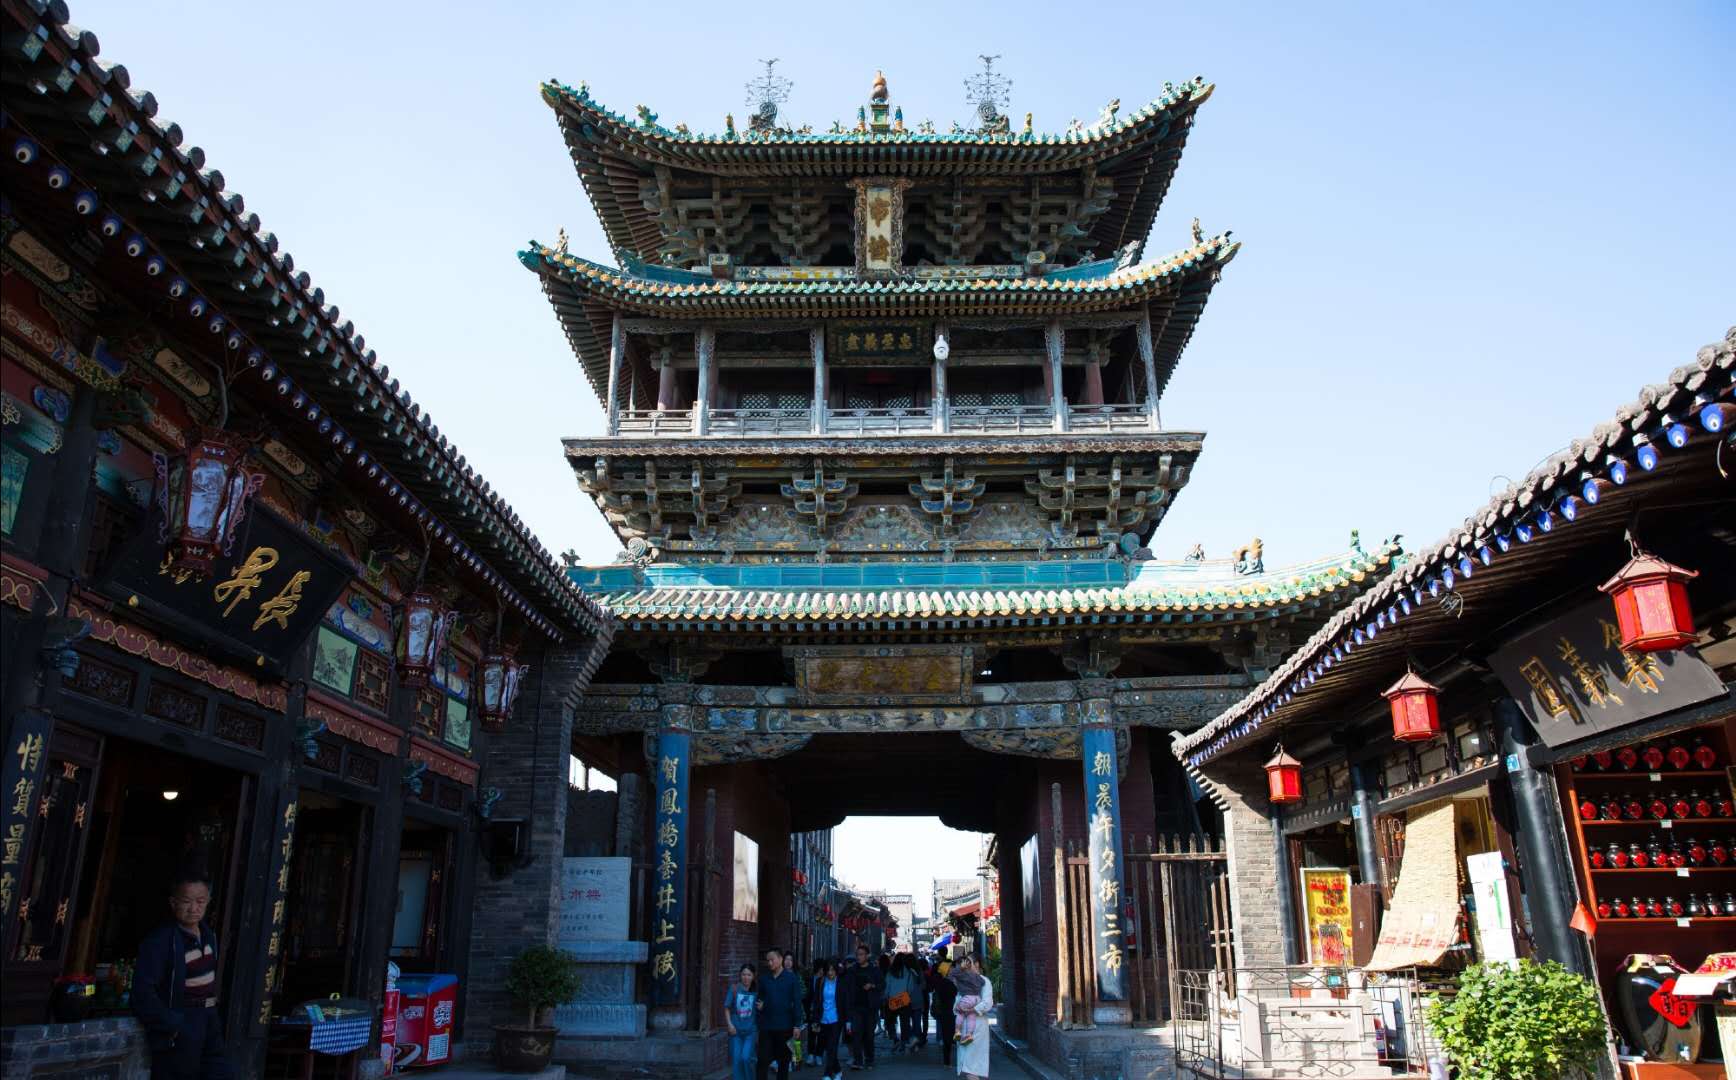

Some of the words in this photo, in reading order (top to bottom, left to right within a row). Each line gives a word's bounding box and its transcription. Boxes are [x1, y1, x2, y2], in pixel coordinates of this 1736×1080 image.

[1092, 751, 1123, 977] 朝晨午夕街三市
